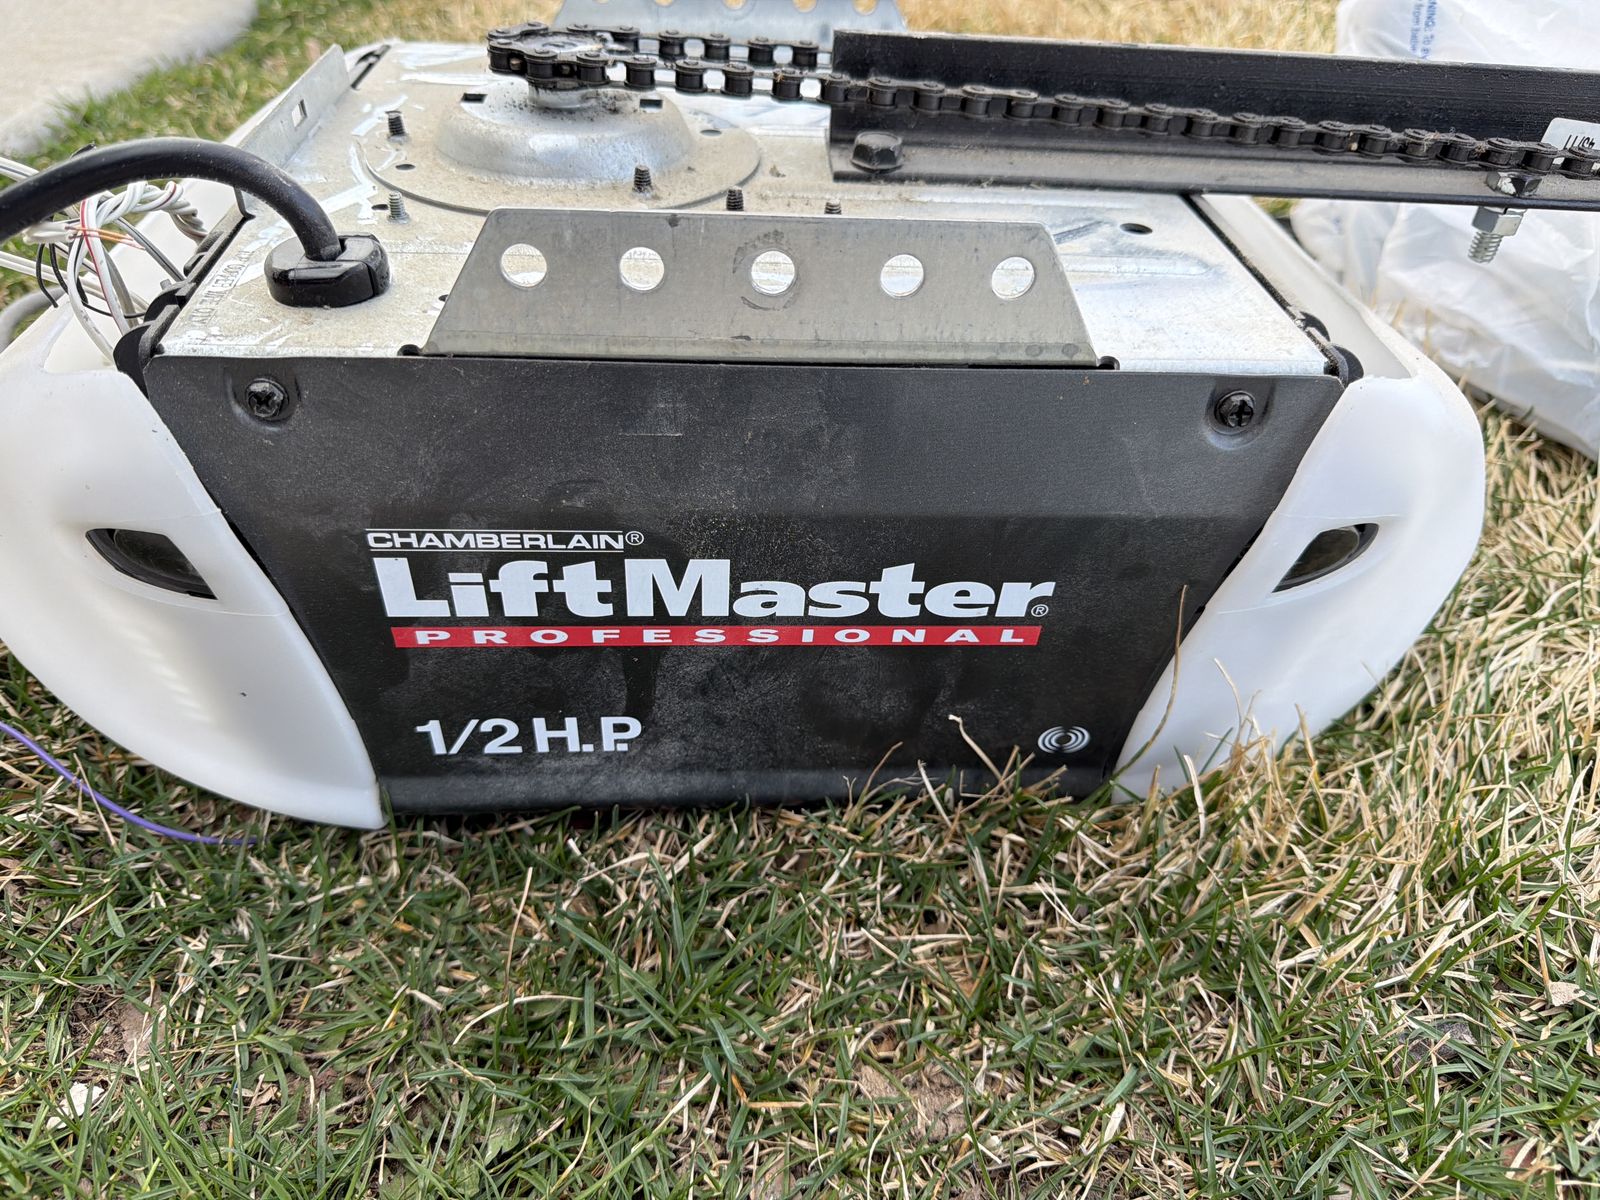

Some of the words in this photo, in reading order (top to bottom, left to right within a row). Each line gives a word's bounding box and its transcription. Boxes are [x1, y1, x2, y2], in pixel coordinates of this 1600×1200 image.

[415, 629, 1025, 645] PROFESSIONAL
[415, 718, 523, 755] 1/2
[532, 716, 643, 753] H.P.
